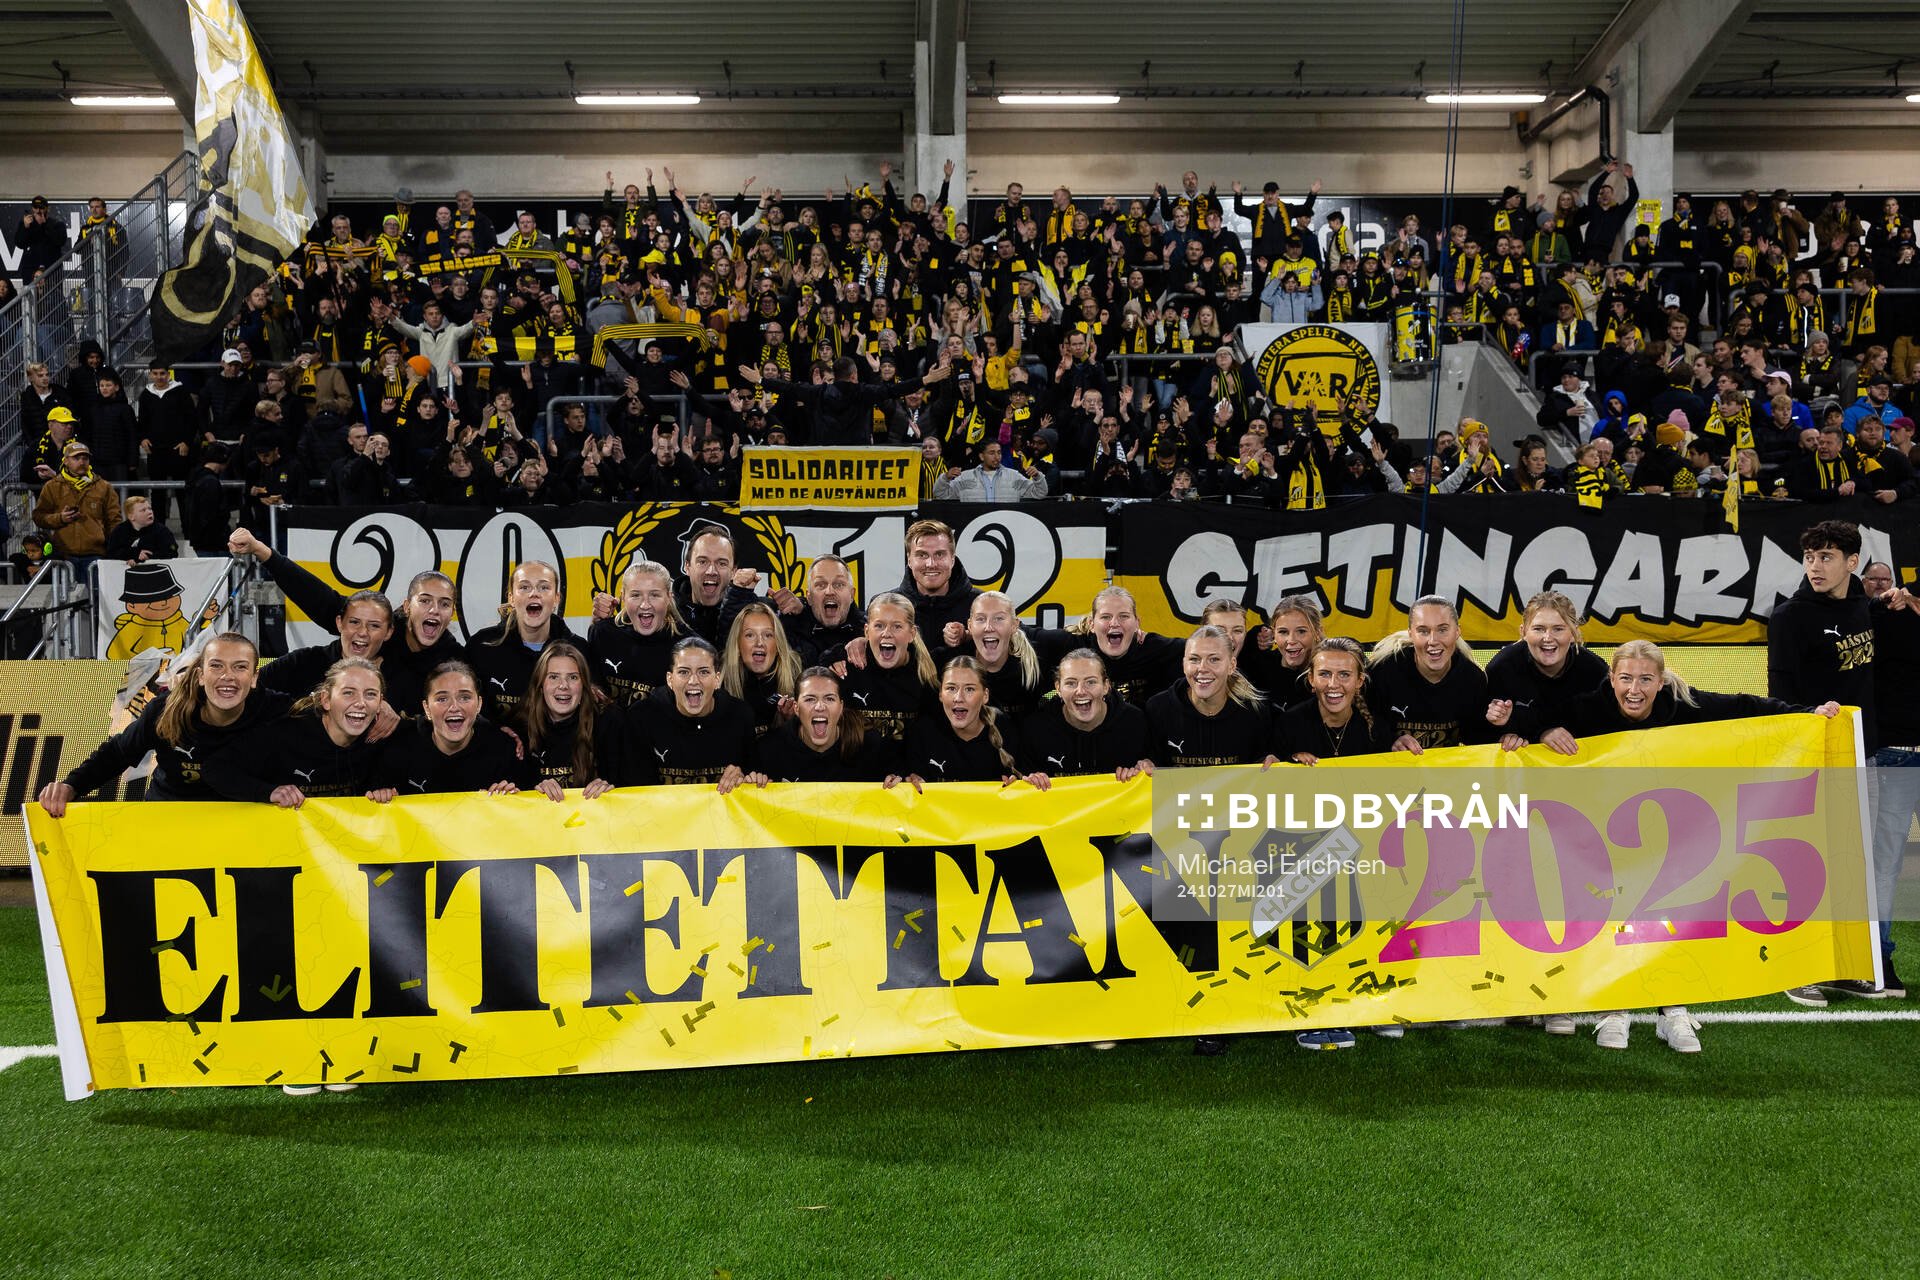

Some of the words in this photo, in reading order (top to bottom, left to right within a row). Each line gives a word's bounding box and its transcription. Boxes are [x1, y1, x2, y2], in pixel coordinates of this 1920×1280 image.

[1291, 327, 1340, 340] SPELET
[1348, 338, 1370, 360] NEJ
[1366, 360, 1379, 388] TILL
[1283, 370, 1348, 399] VAR
[749, 458, 910, 480] SOLIDARITET
[752, 486, 785, 499] MED
[790, 487, 809, 499] DE
[813, 485, 907, 499] AVSTÄNGDA
[1379, 769, 1827, 963] 2025
[87, 831, 1230, 1024] ELITETTAN
